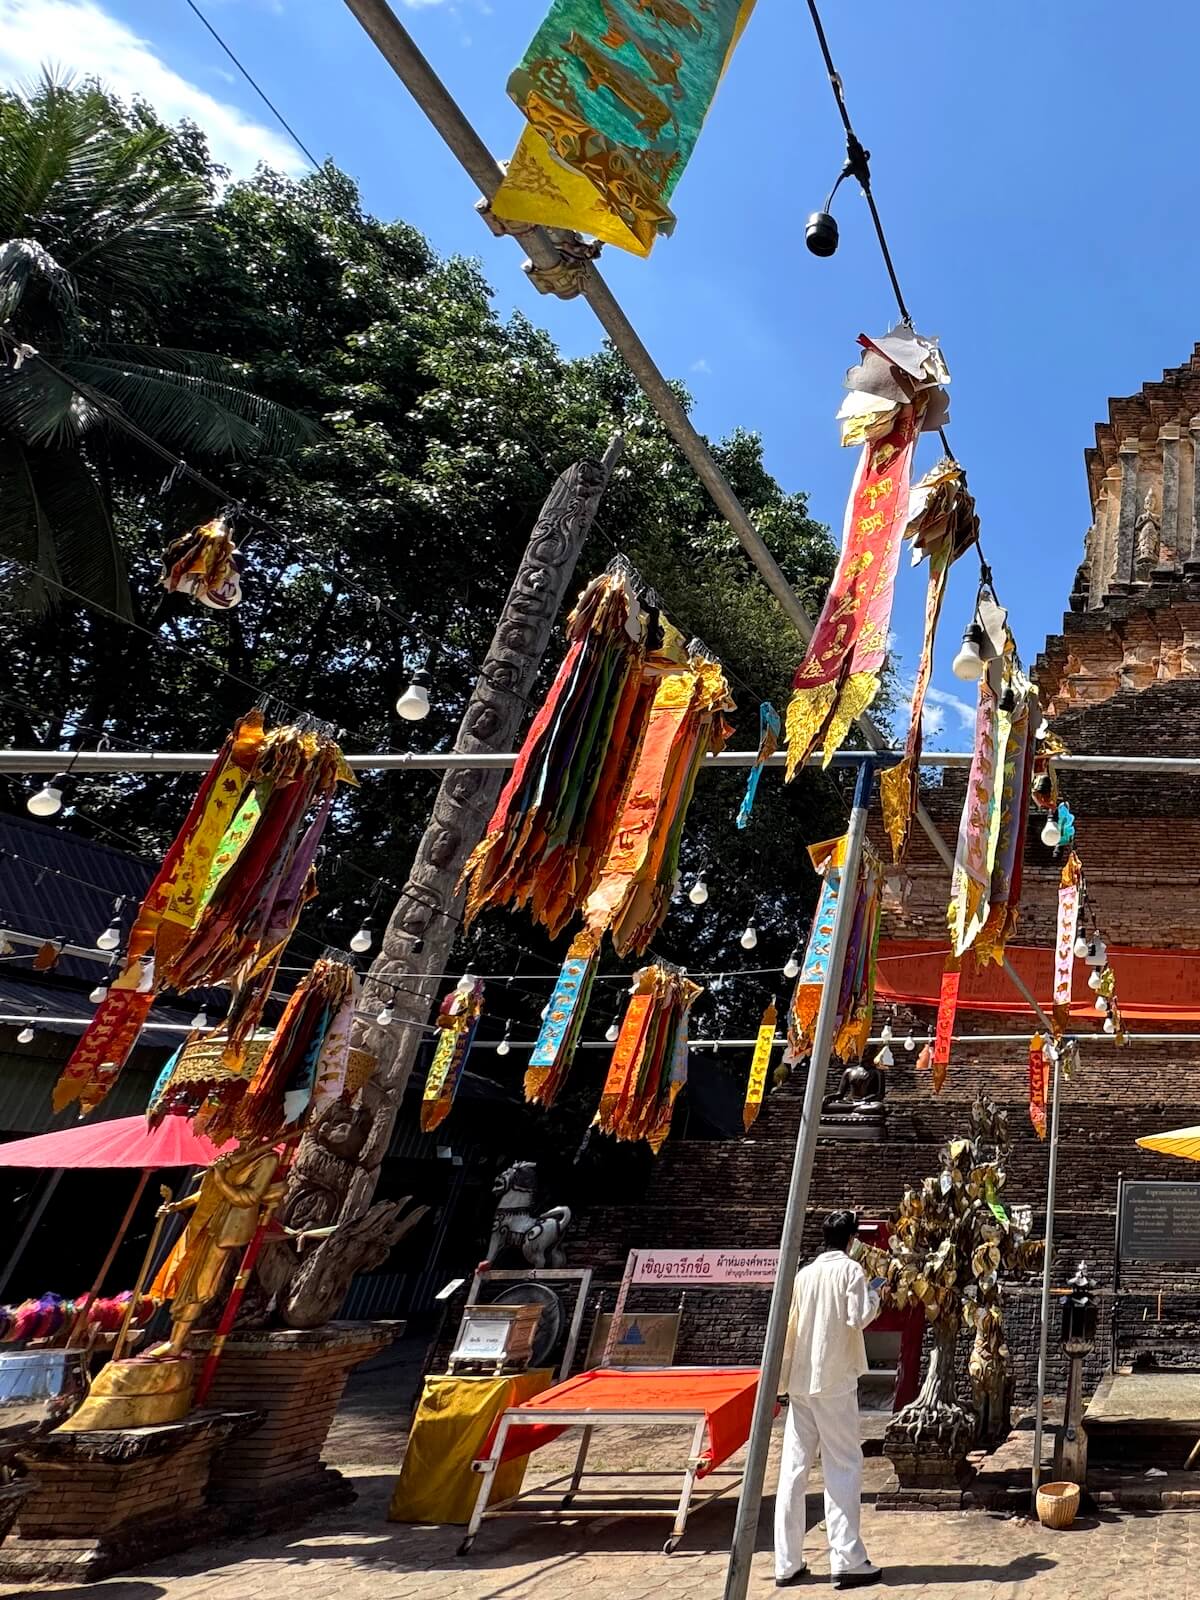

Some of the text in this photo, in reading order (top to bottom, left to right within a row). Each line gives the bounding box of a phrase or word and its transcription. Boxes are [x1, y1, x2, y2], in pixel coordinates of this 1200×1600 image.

[641, 1255, 710, 1278] เชิญจารึกชื่อ
